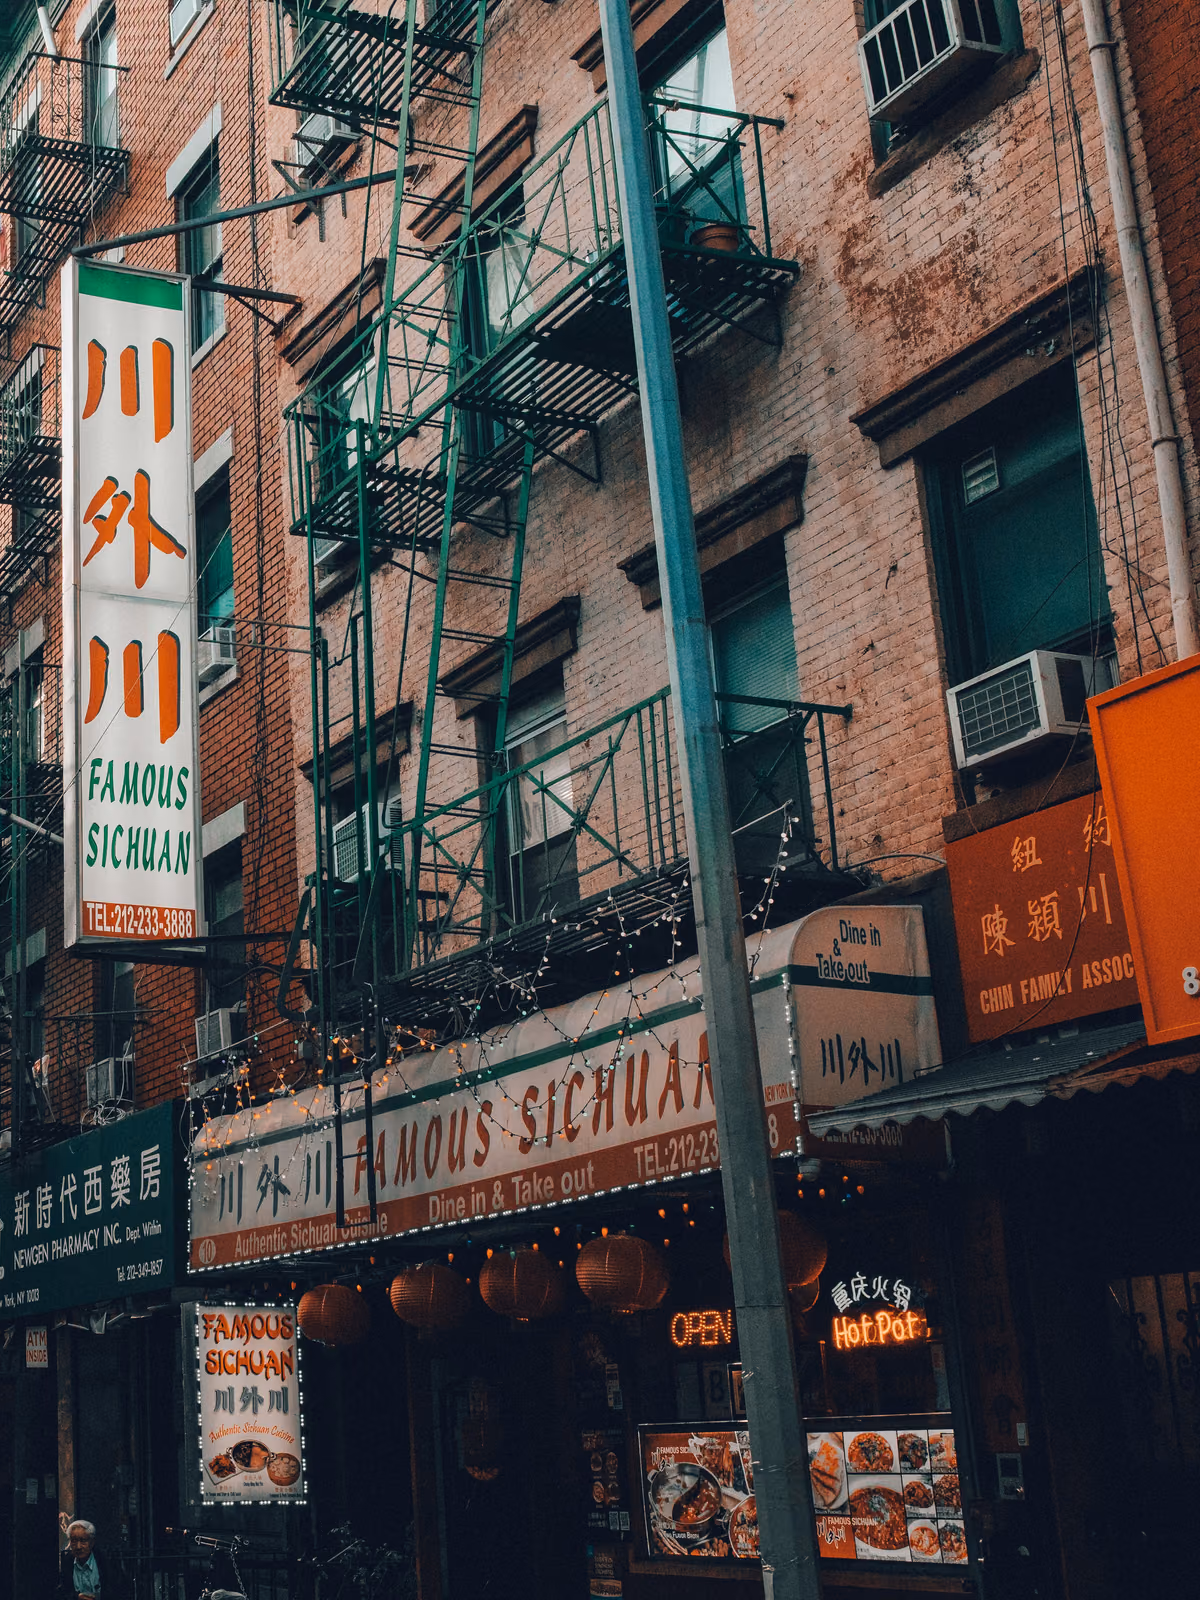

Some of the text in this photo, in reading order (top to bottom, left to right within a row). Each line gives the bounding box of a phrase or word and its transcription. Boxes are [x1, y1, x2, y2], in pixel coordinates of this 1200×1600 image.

[82, 337, 188, 745] 川外川
[89, 757, 190, 811] FAMOUS
[86, 822, 191, 876] SICHUAN
[86, 902, 192, 938] TEL:212-233-3888
[839, 919, 882, 947] Dine in
[833, 938, 841, 957] &
[816, 954, 868, 983] Take out
[979, 984, 1015, 1015] CHIN
[1020, 967, 1074, 1006] FAMILY
[820, 1033, 903, 1086] 川外川
[354, 1030, 715, 1196] FAMOUS SICHUAN
[13, 1143, 162, 1237] 新時代西藥房
[218, 1140, 332, 1225] 川外川
[428, 1159, 595, 1223] Dine in & Take out
[13, 1242, 49, 1271] NEWGEN
[51, 1228, 100, 1260] PHARMACY
[103, 1222, 122, 1247] INC.
[234, 1228, 287, 1258] Authentic
[290, 1222, 337, 1251] Sichuan
[17, 1291, 25, 1305] NY
[26, 1330, 47, 1347] ATM
[202, 1313, 295, 1346] FAMOUS
[671, 1309, 733, 1346] OPEN
[834, 1310, 919, 1349] Hot Pot
[26, 1350, 47, 1363] INSIDE
[205, 1345, 295, 1381] SICHUAN
[213, 1385, 290, 1415] 川外川
[208, 1423, 242, 1444] Authentic
[270, 1425, 295, 1444] Cuisine
[828, 1517, 851, 1526] FAMOUS
